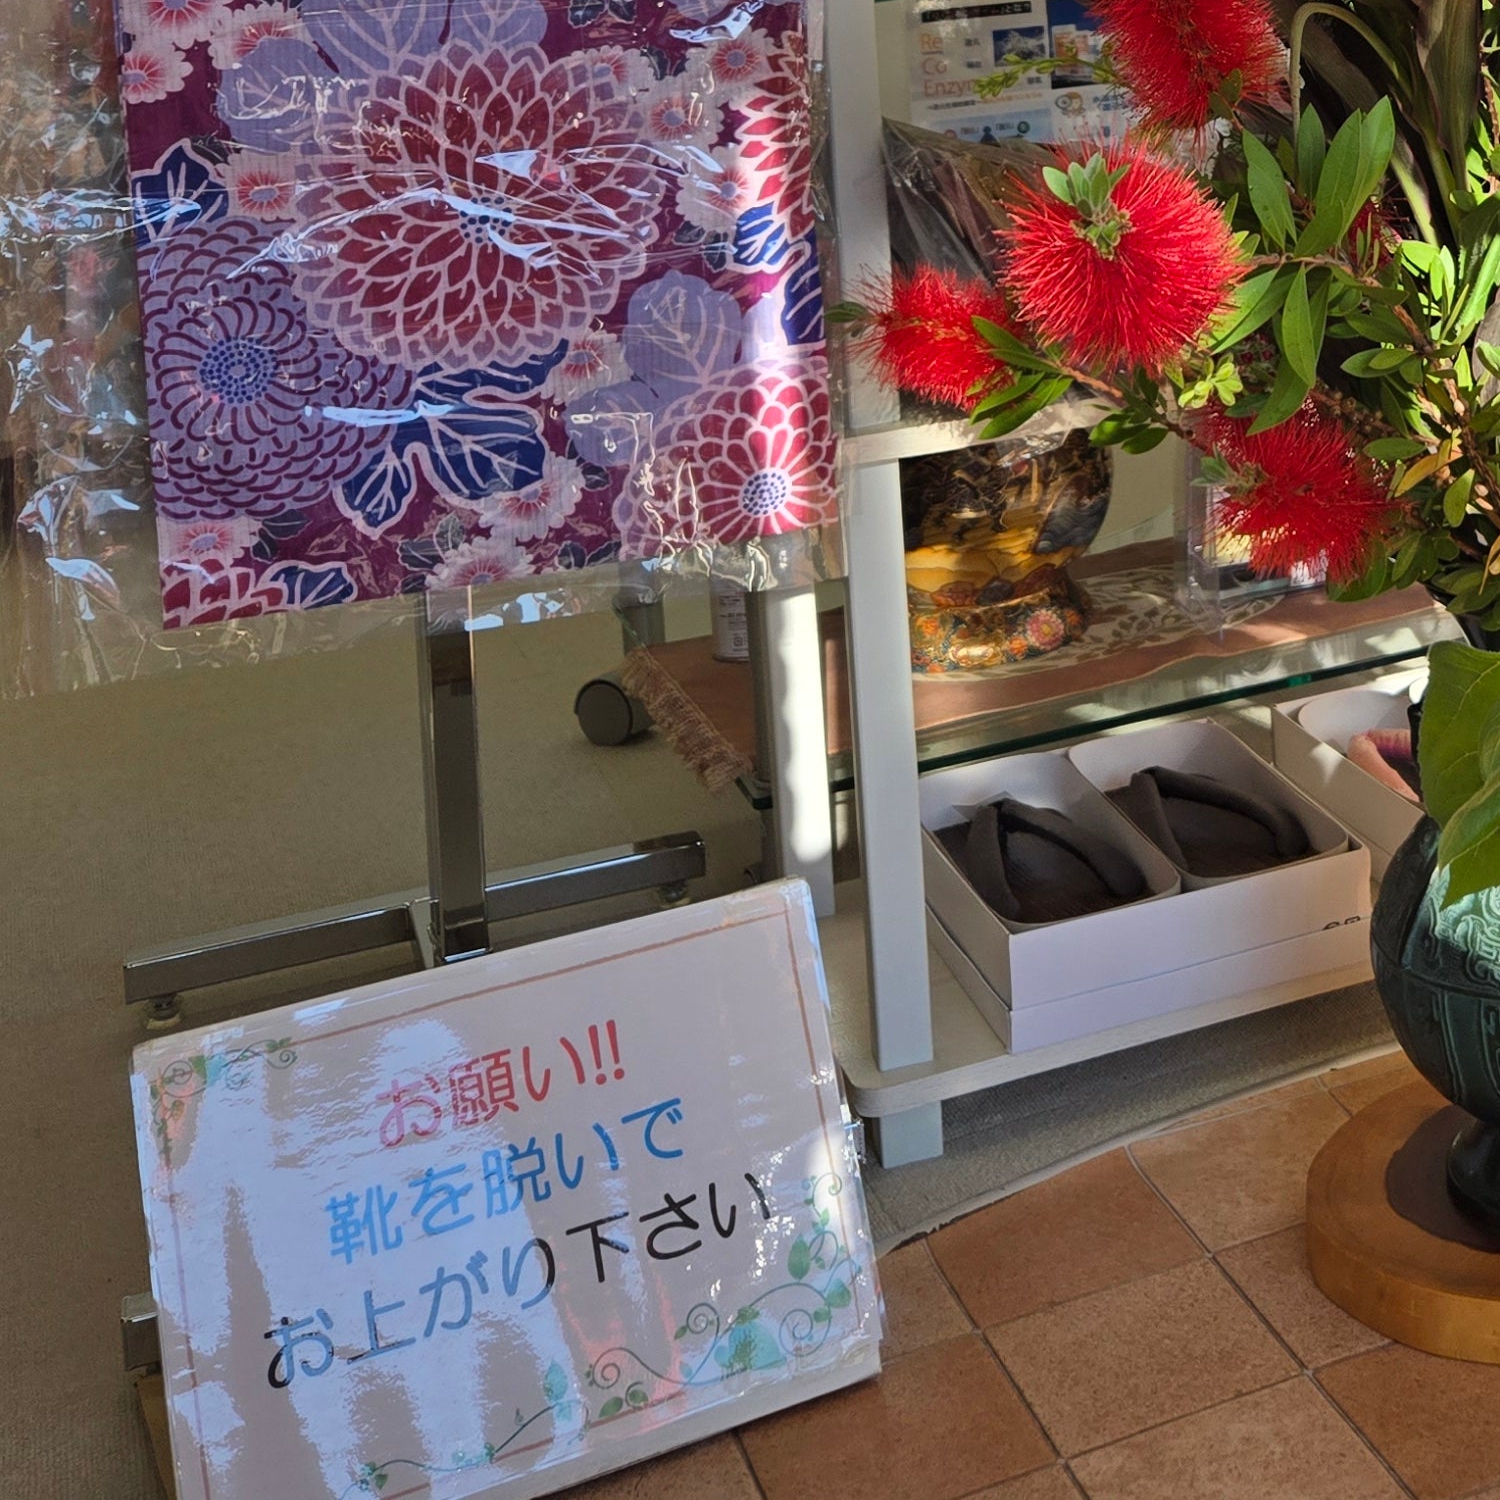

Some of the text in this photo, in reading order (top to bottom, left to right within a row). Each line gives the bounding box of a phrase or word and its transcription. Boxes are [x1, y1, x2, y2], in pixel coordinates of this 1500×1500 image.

[377, 1019, 628, 1149] お願い!!
[324, 1097, 684, 1266] 靴を脱いで
[264, 1172, 771, 1389] お上がり下さい
